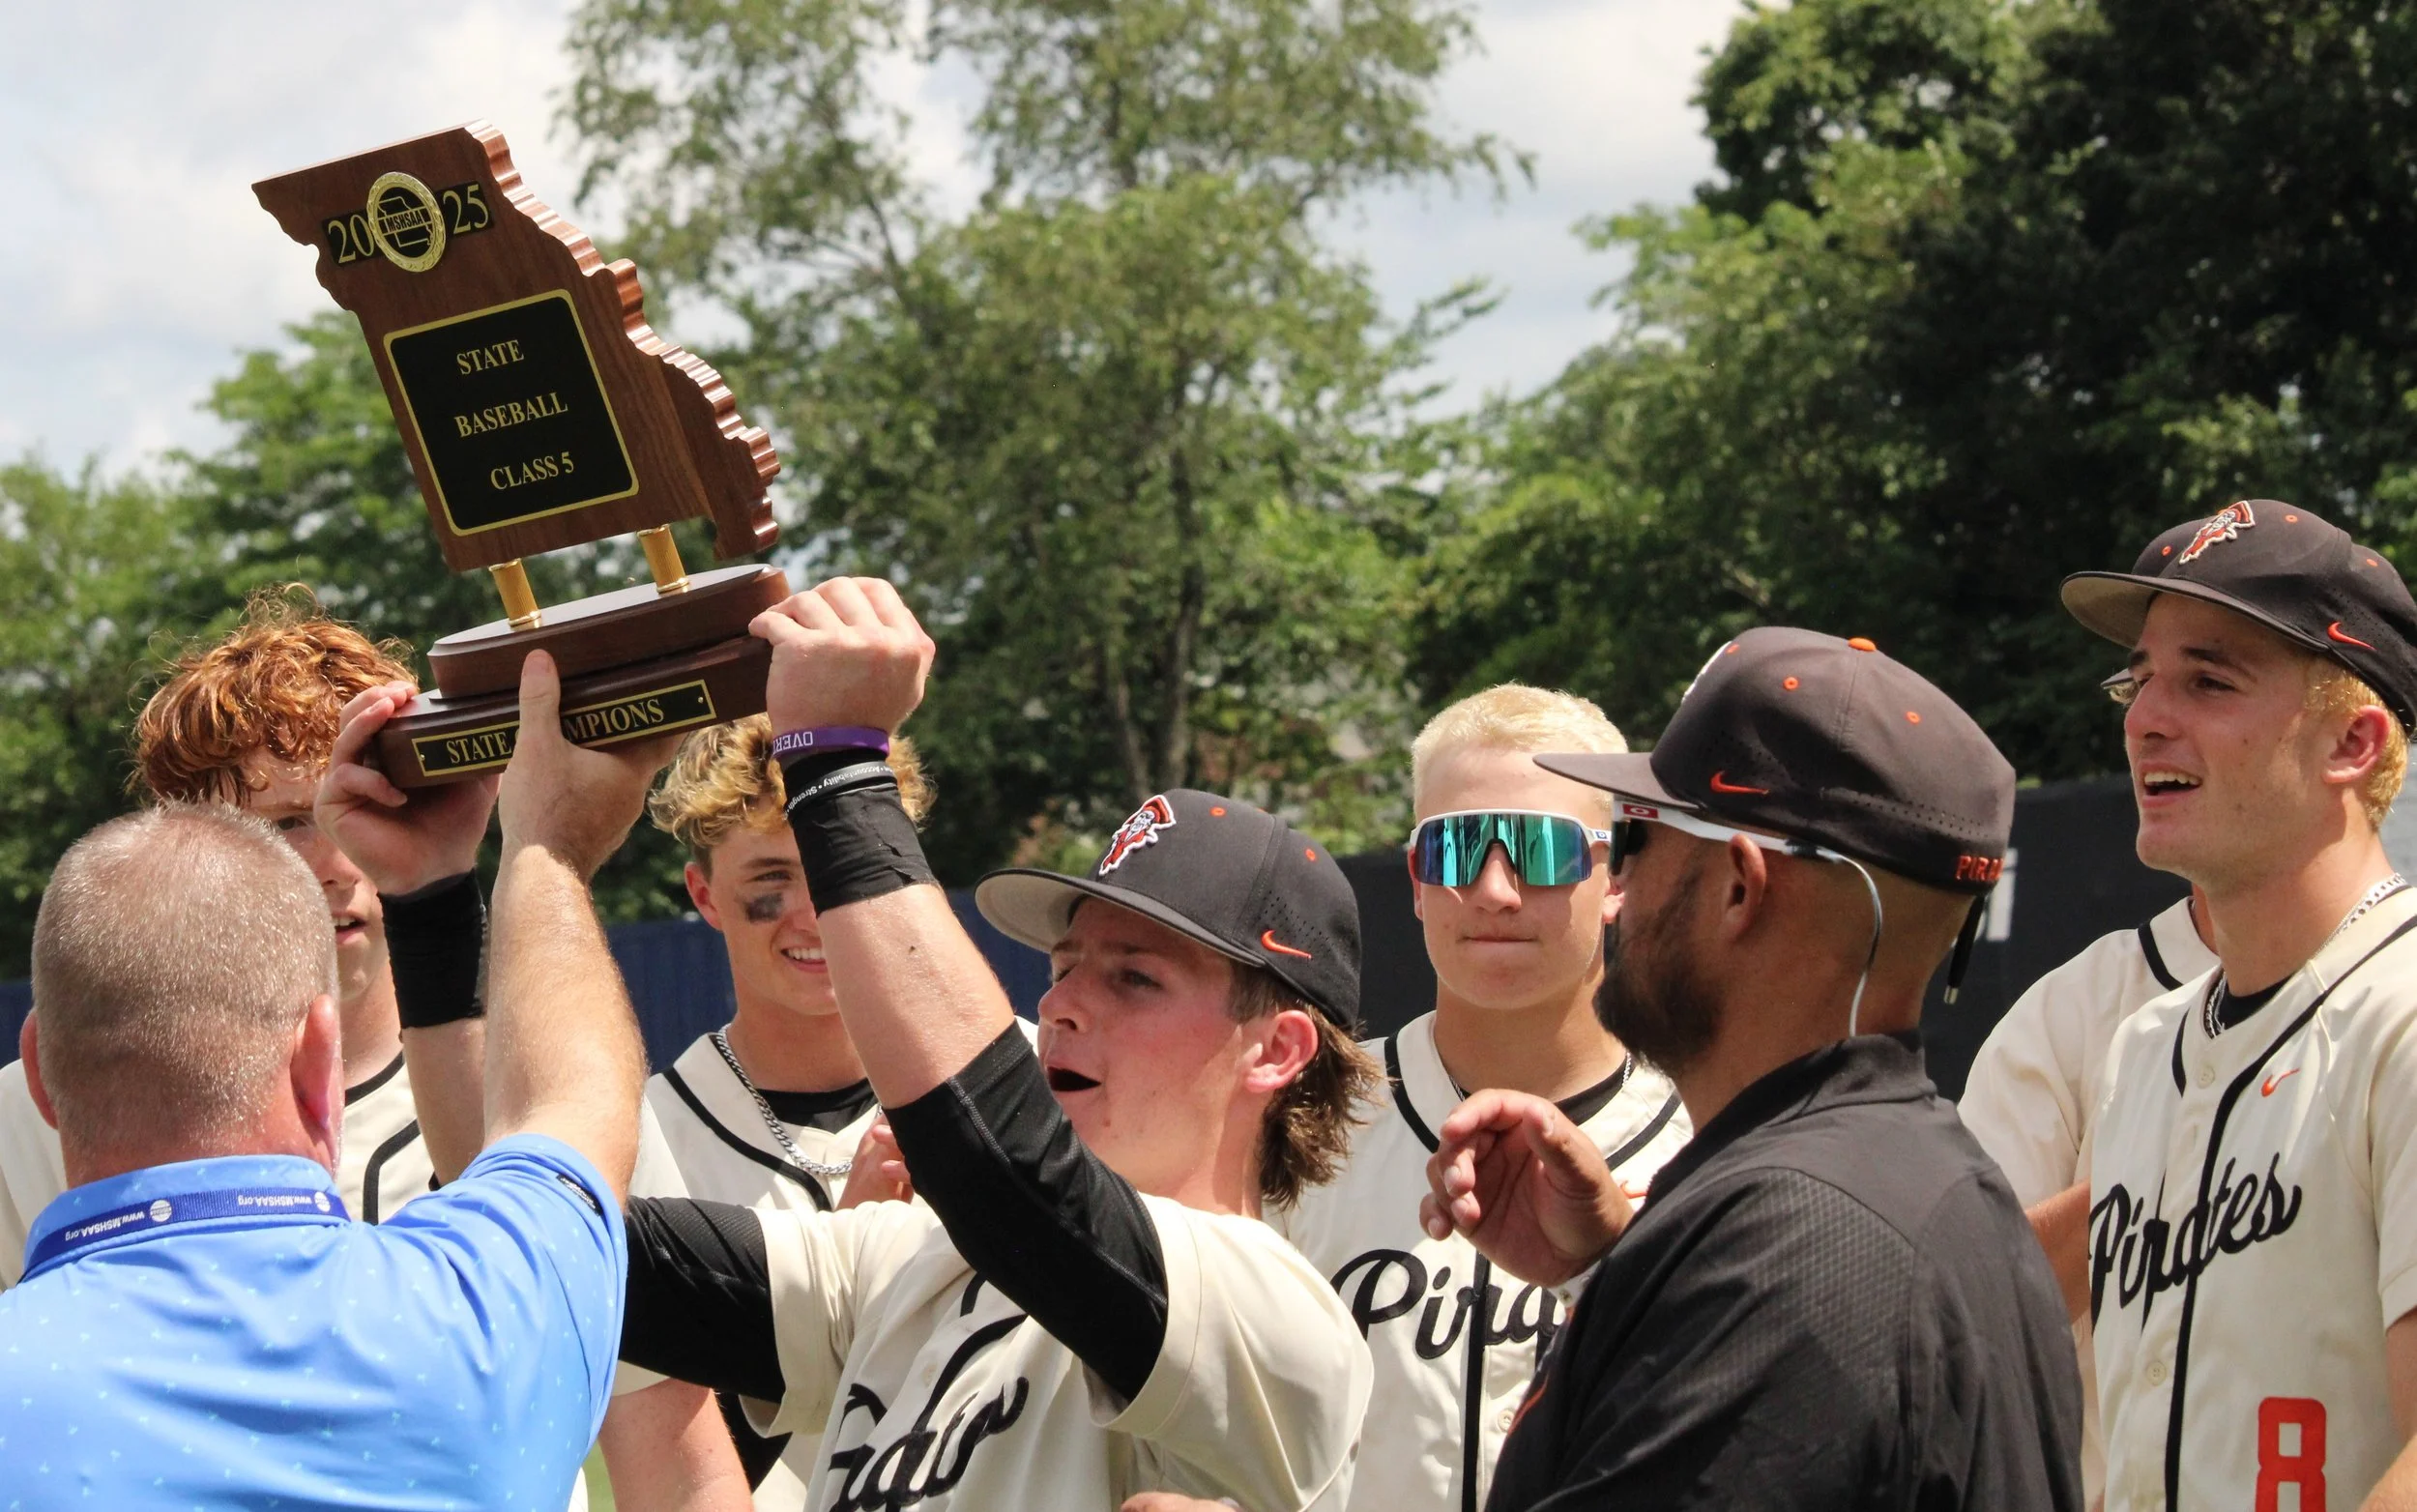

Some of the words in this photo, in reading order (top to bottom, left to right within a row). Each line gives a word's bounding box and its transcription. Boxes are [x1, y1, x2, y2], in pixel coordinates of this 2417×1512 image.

[388, 210, 423, 233] MSHSAA
[456, 339, 525, 375] STATE
[453, 392, 568, 438] BASEBALL
[490, 455, 559, 490] CLASS
[561, 451, 574, 474] 5
[446, 729, 513, 764] STATE
[514, 699, 665, 750] MPIONS
[823, 765, 881, 787] Accountability
[788, 785, 818, 811] Strength
[238, 1194, 312, 1207] www.MSHSAA.org
[65, 1210, 145, 1241] www.MSHSAA.org
[2088, 1151, 2302, 1336] Pirates
[1330, 1248, 1560, 1359] Pira
